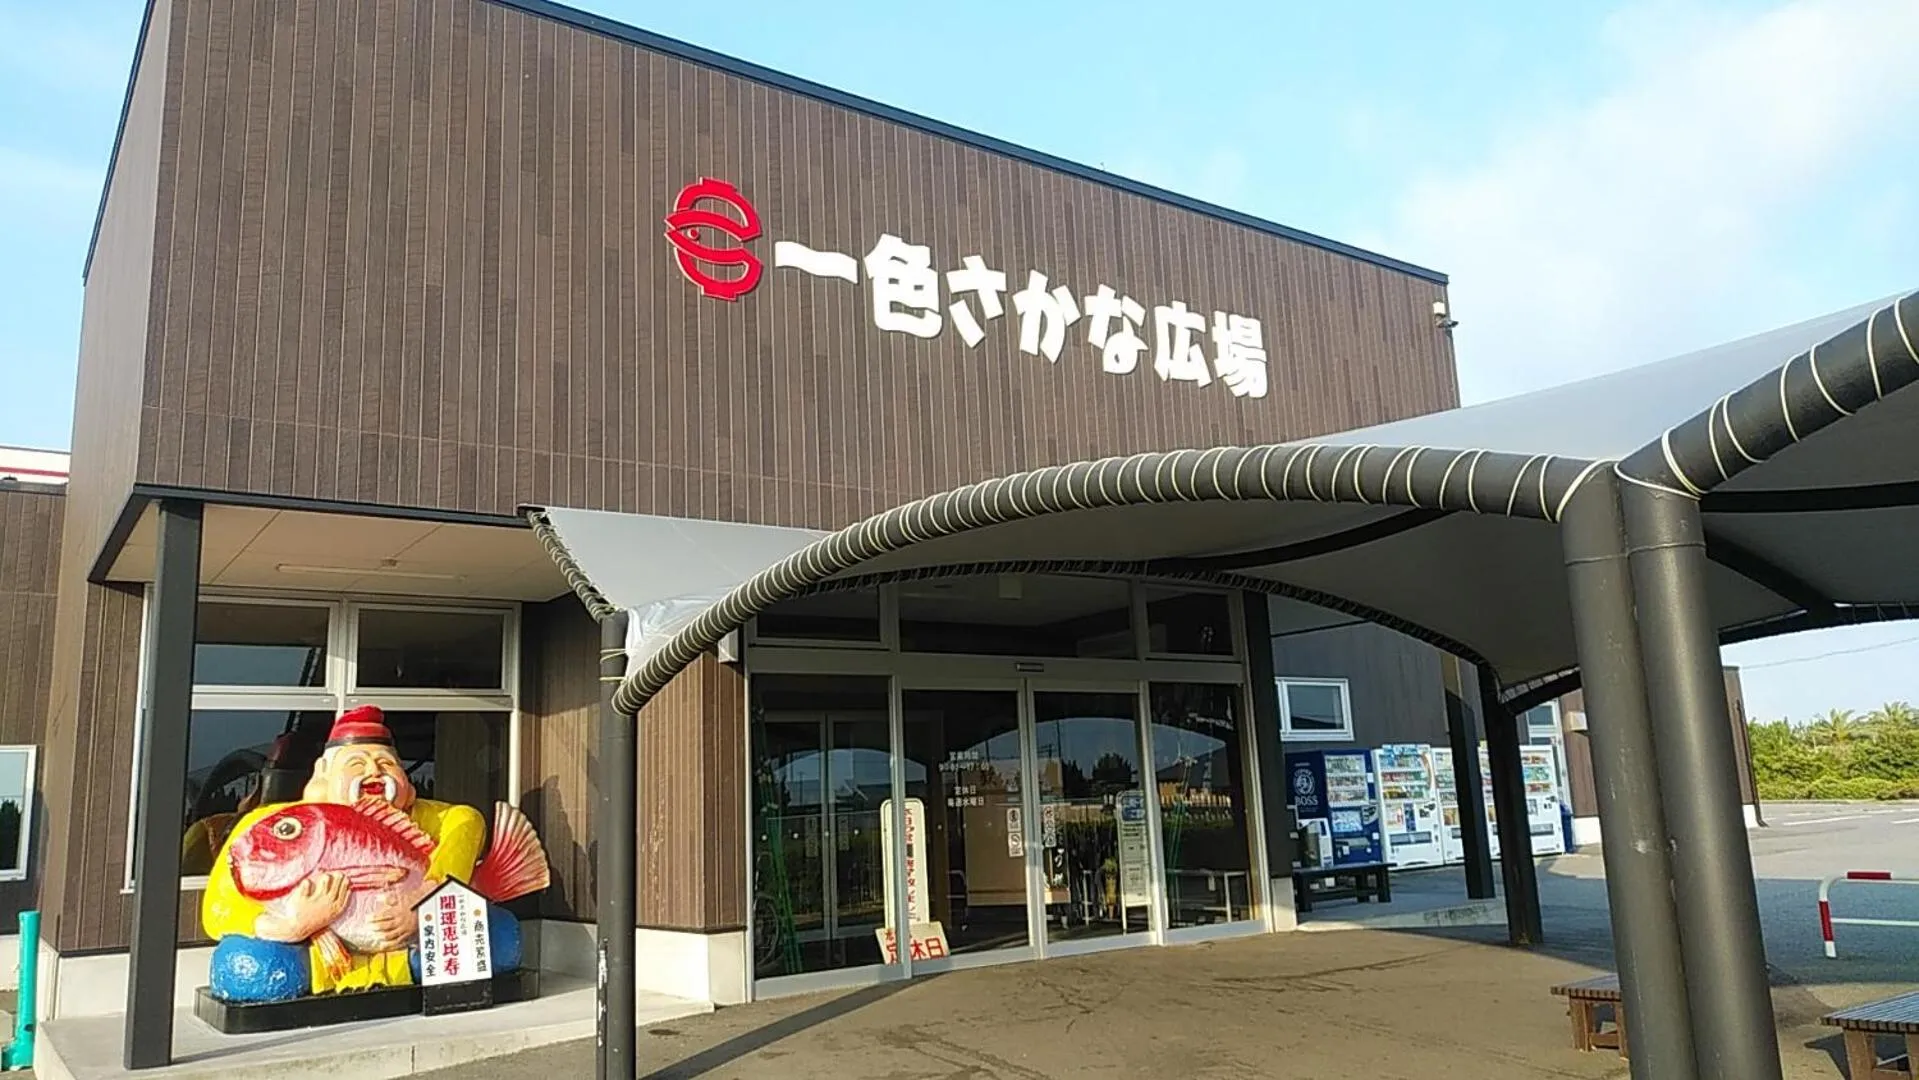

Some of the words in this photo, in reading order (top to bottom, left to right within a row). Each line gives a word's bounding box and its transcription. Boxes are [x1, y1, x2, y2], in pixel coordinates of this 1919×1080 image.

[774, 231, 1269, 399] 一色さかな広場
[954, 784, 977, 795] 定休日
[947, 796, 985, 807] 毎週水曜日
[1294, 795, 1319, 806] BOSS
[424, 924, 436, 977] 家内安全
